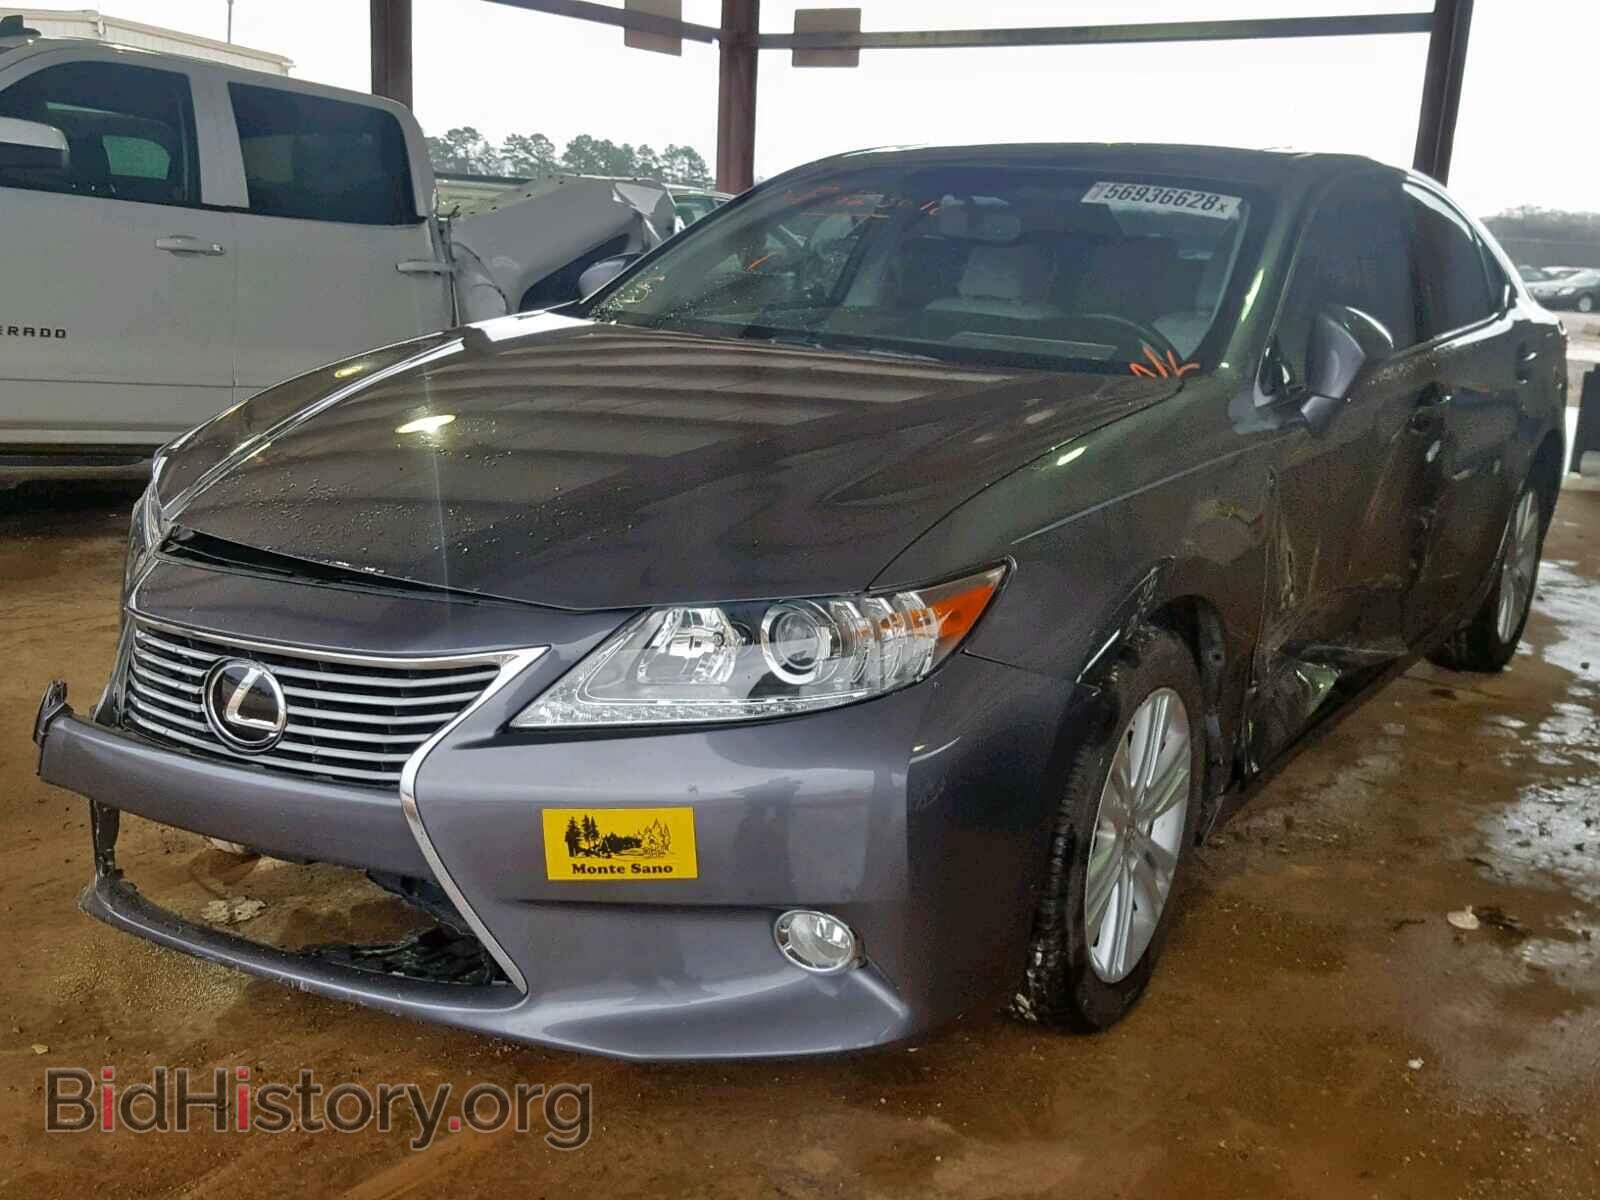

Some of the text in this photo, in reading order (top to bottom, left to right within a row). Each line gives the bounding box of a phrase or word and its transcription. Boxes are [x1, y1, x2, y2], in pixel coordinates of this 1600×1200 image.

[1104, 183, 1220, 212] 56936628
[0, 325, 66, 339] RADO
[571, 863, 674, 875] Monte Sano
